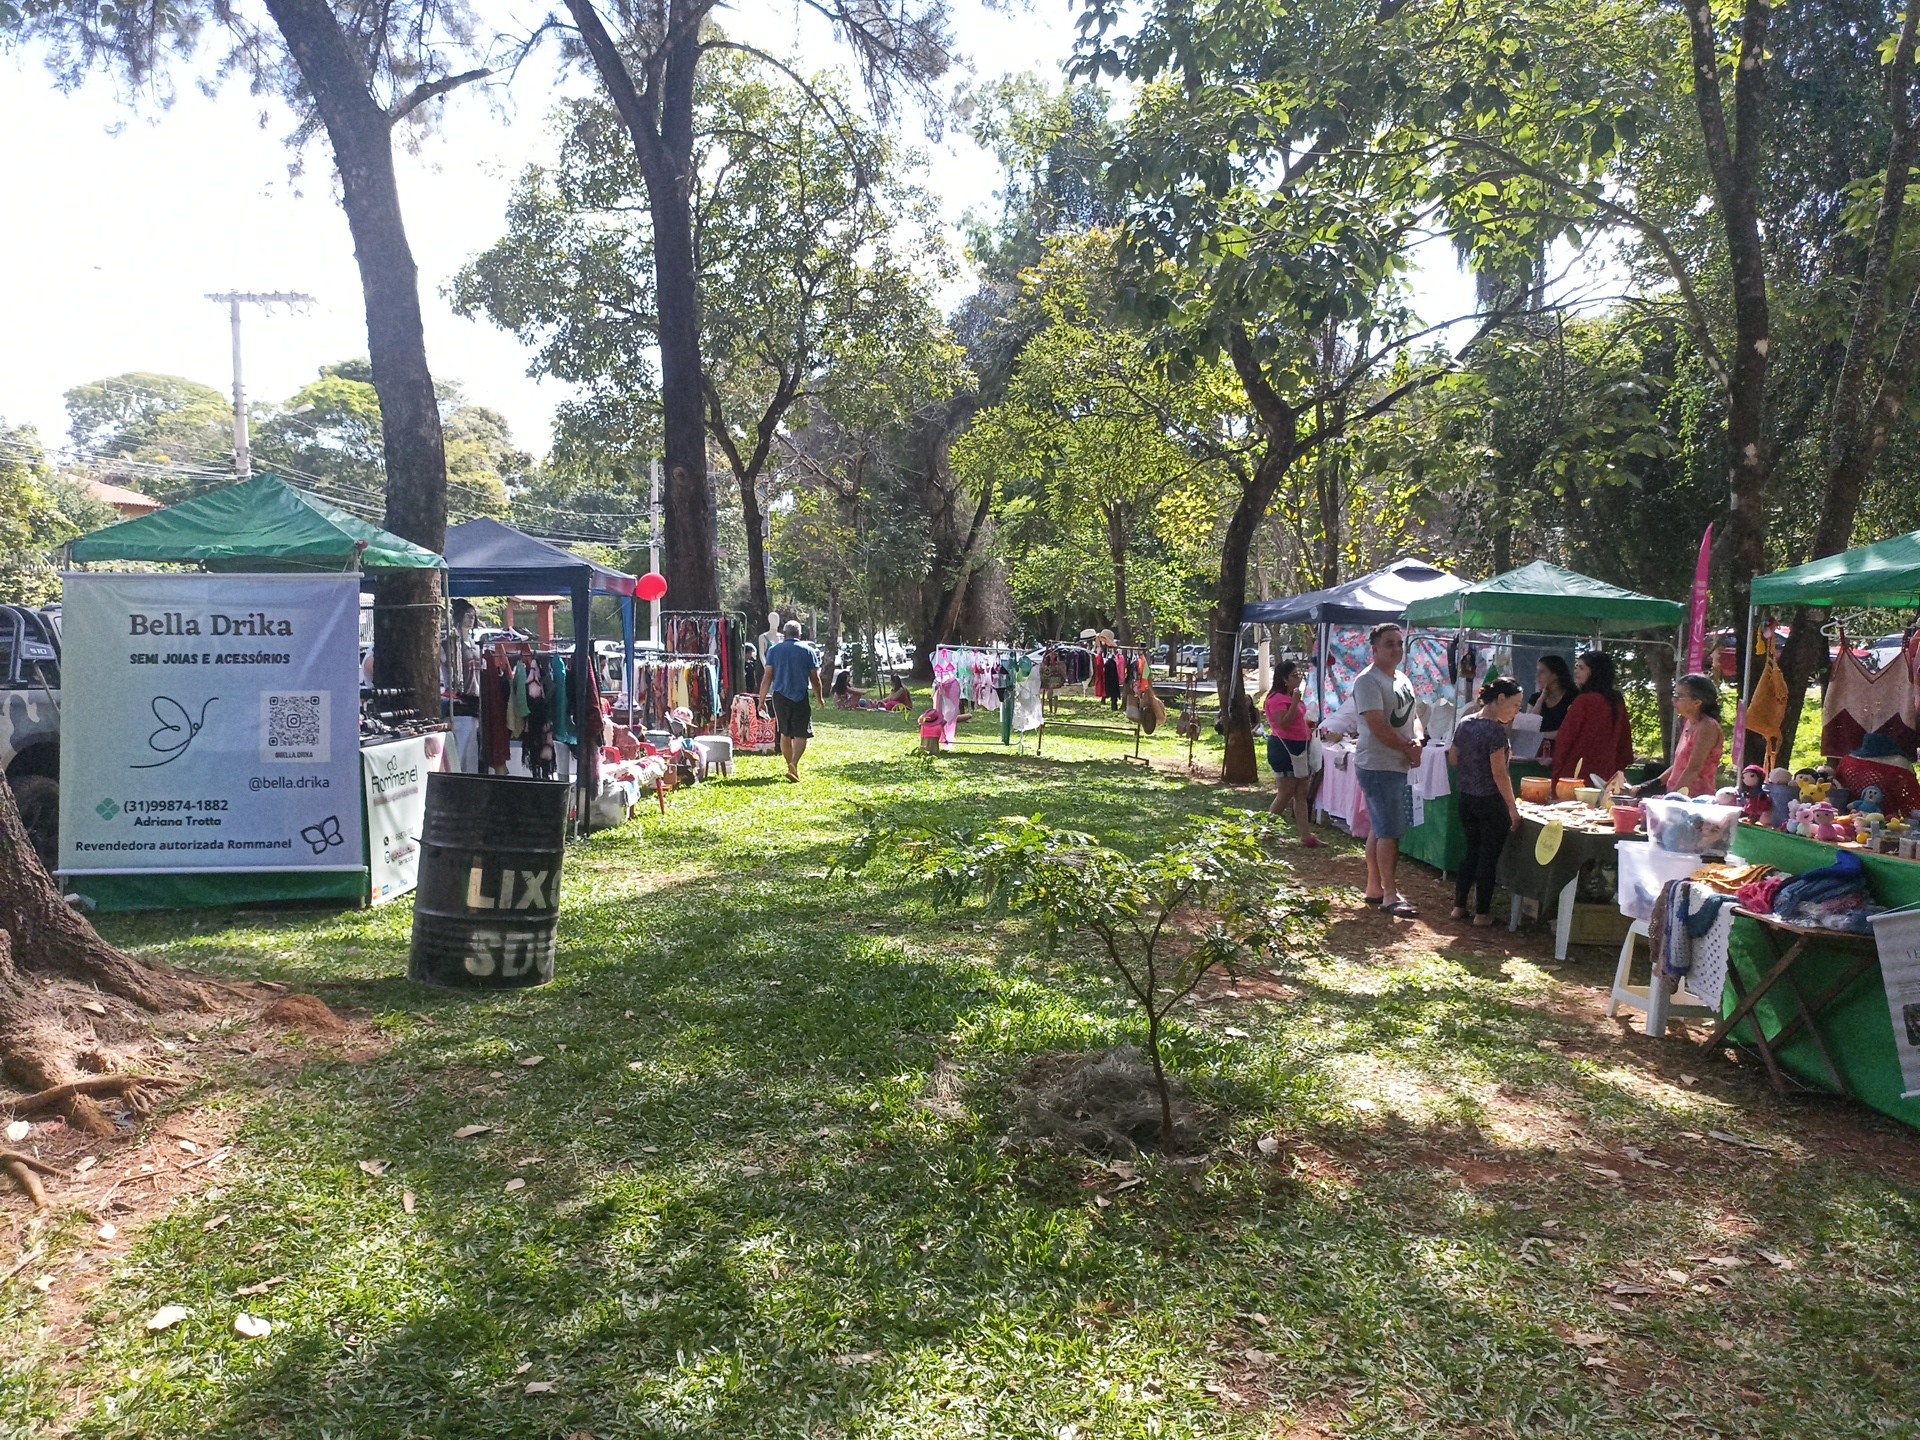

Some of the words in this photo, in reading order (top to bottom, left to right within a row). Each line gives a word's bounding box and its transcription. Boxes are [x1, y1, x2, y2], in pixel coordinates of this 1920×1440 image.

[129, 612, 201, 636] Bella
[210, 612, 293, 636] Drika
[130, 653, 158, 664] SEMI
[163, 653, 198, 664] JOIAS
[202, 653, 210, 664] E
[215, 650, 290, 664] ACESSÓRIOS
[248, 776, 330, 791] @bella.drika
[371, 764, 418, 794] Rommanel
[124, 799, 228, 813] (31)99874-1882
[134, 815, 183, 827] Adriana
[185, 815, 222, 827] Trotta
[75, 840, 156, 852] Revendedora
[159, 838, 224, 851] autorizada
[227, 838, 291, 850] Rommanel
